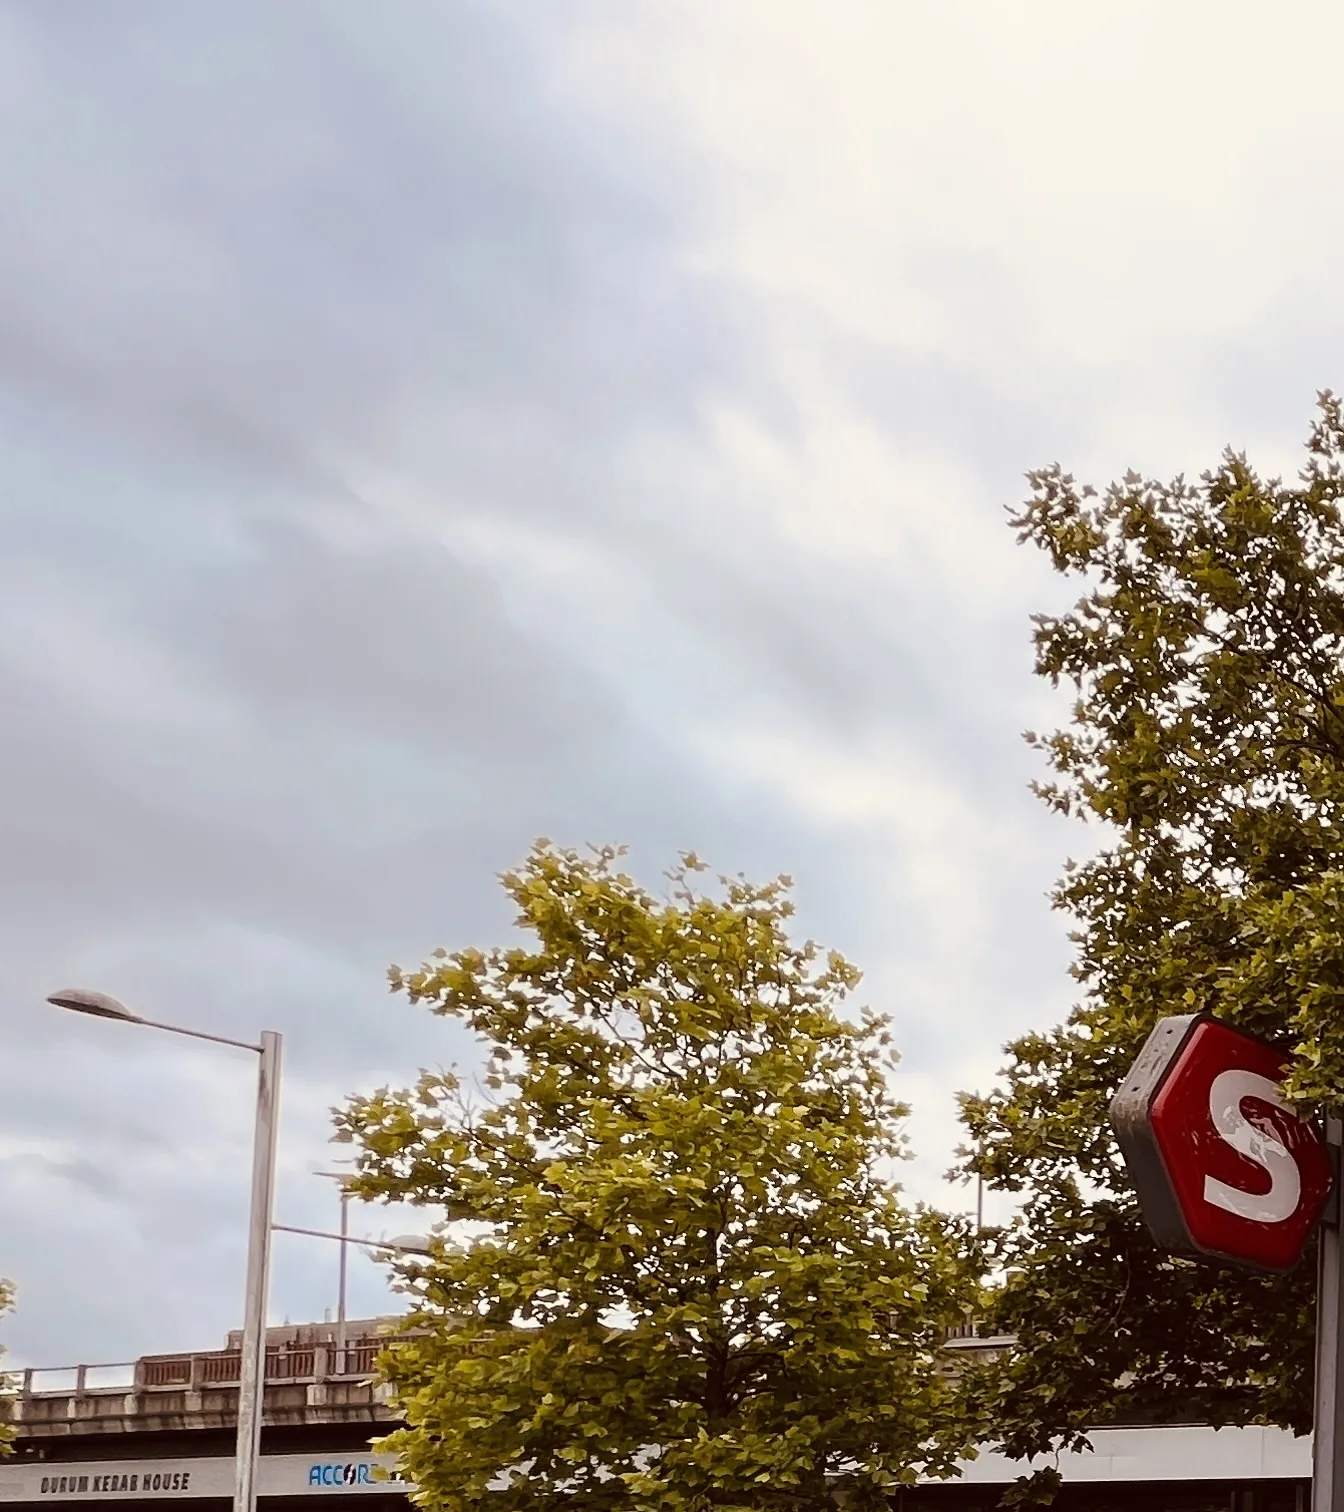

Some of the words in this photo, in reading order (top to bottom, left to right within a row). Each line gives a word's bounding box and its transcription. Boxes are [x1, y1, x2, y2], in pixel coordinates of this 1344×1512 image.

[1203, 1069, 1300, 1223] S
[92, 1474, 139, 1492] KEBAB
[142, 1472, 191, 1491] HOUSE
